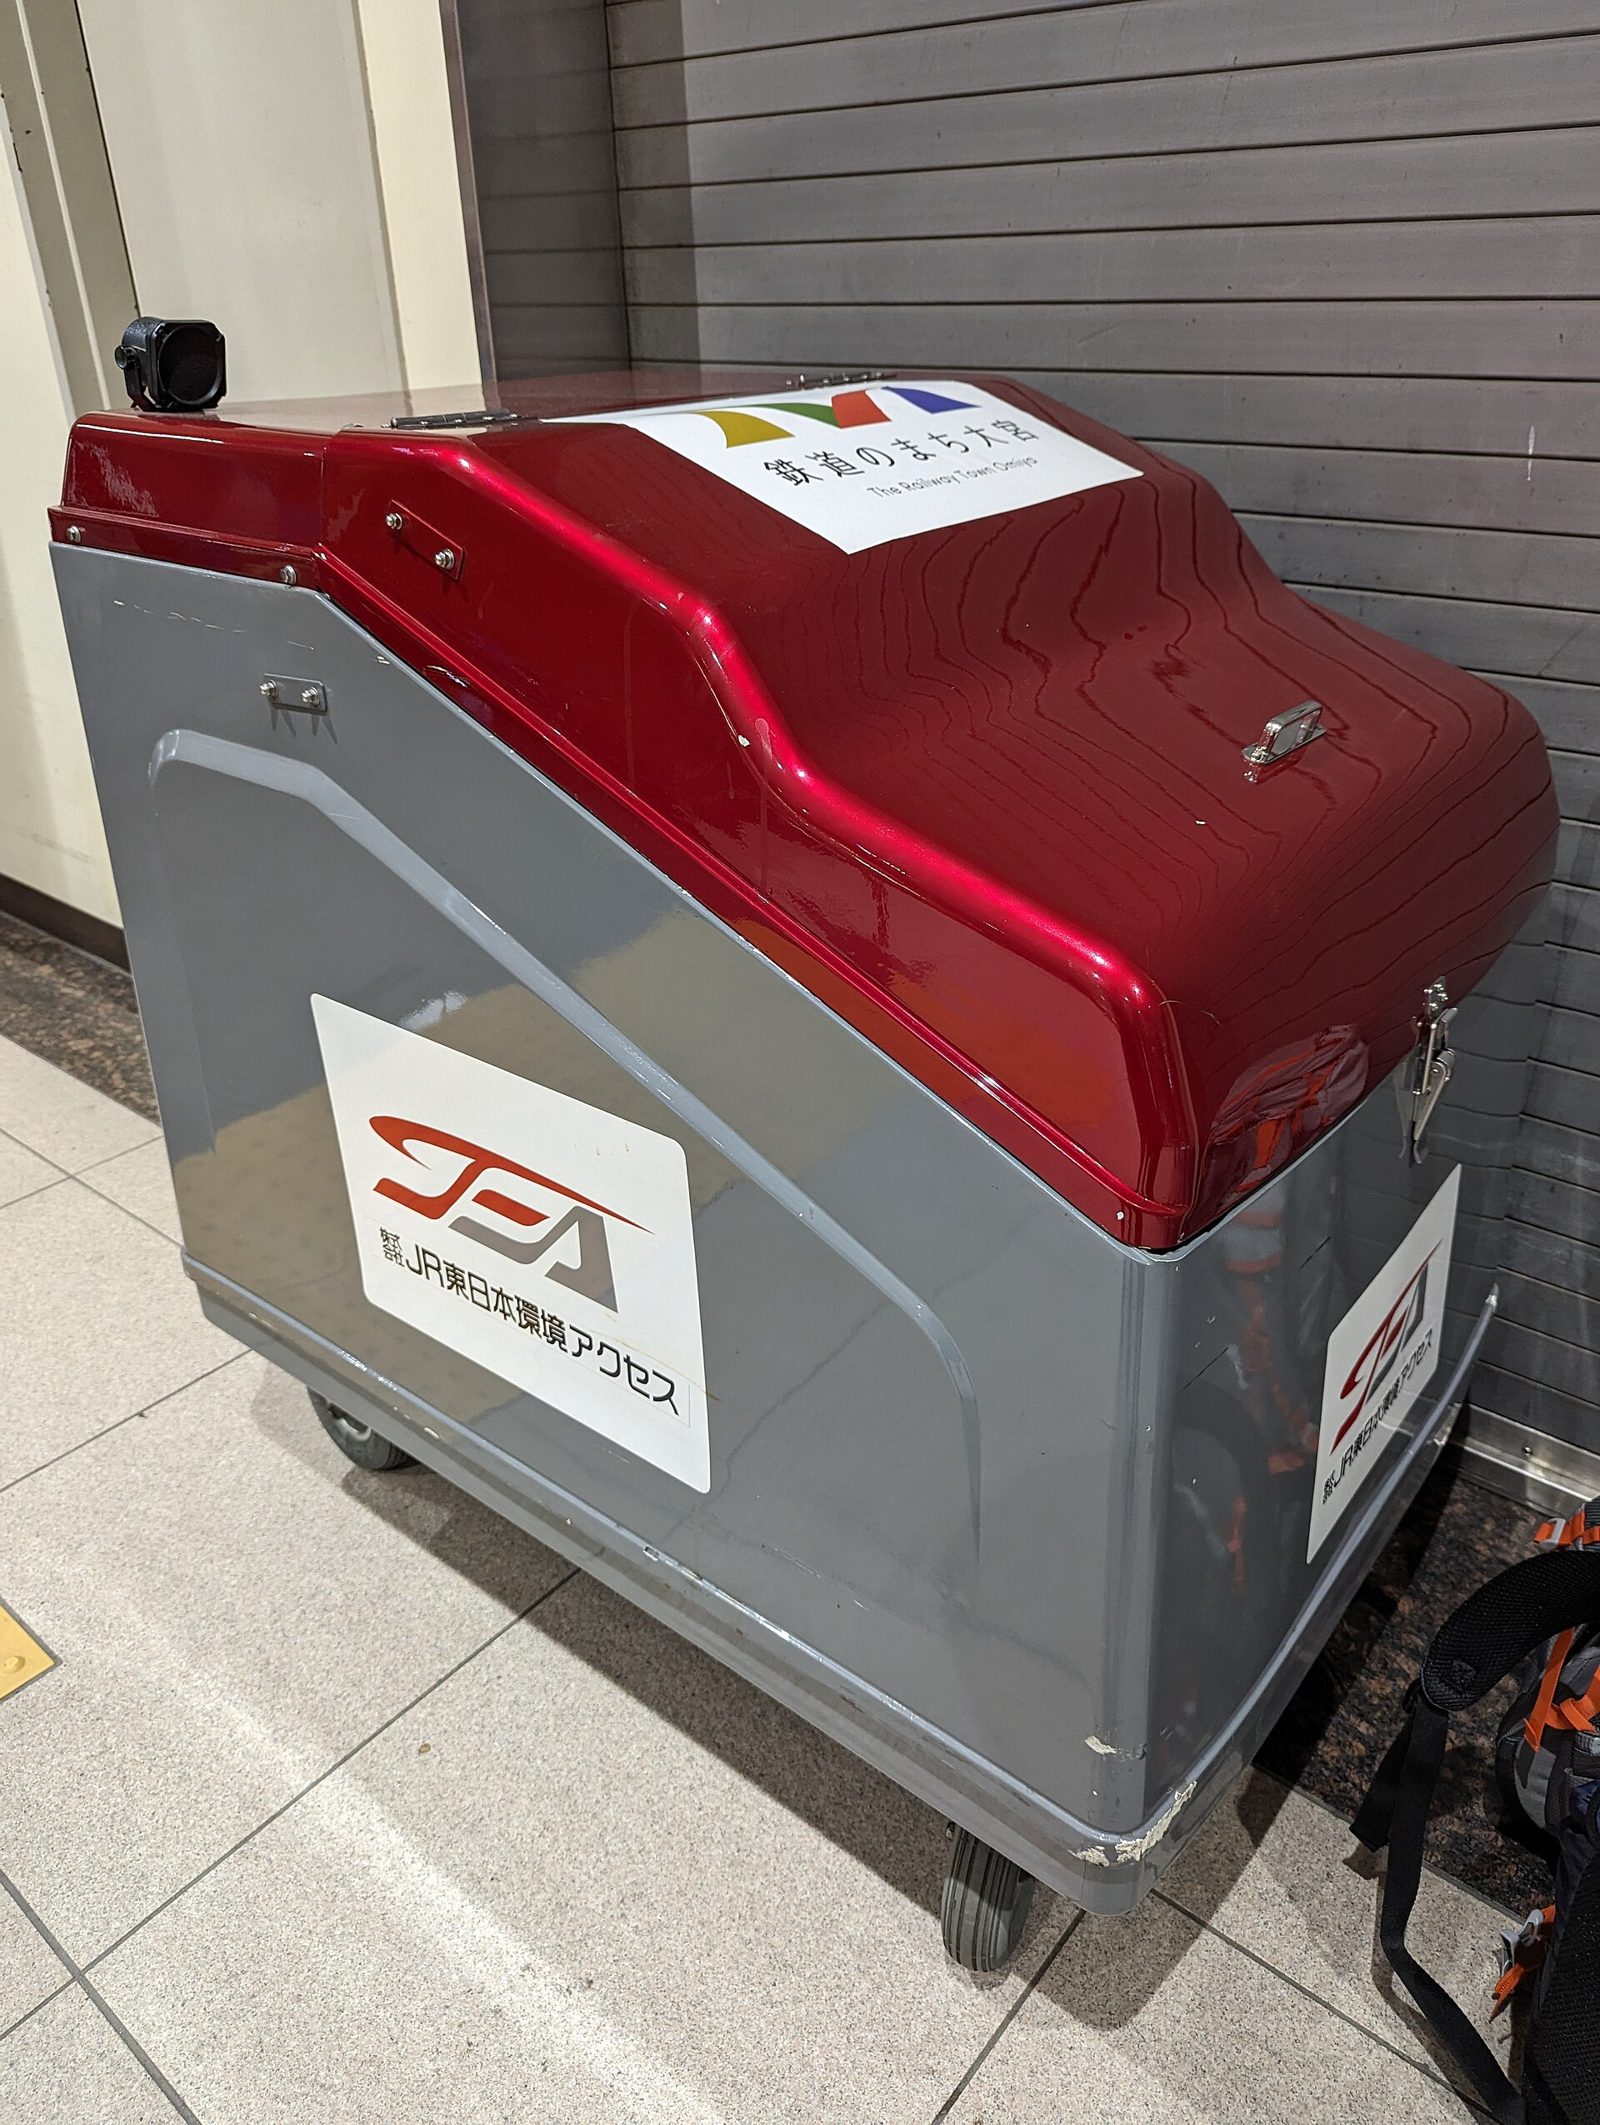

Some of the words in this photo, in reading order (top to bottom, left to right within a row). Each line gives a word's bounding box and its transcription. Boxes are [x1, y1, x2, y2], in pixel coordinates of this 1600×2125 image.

[763, 418, 1040, 487] 鉄道のまち大宮
[866, 485, 902, 499] The
[898, 477, 961, 493] Railway
[952, 465, 997, 480] Town
[992, 456, 1038, 472] Omiya
